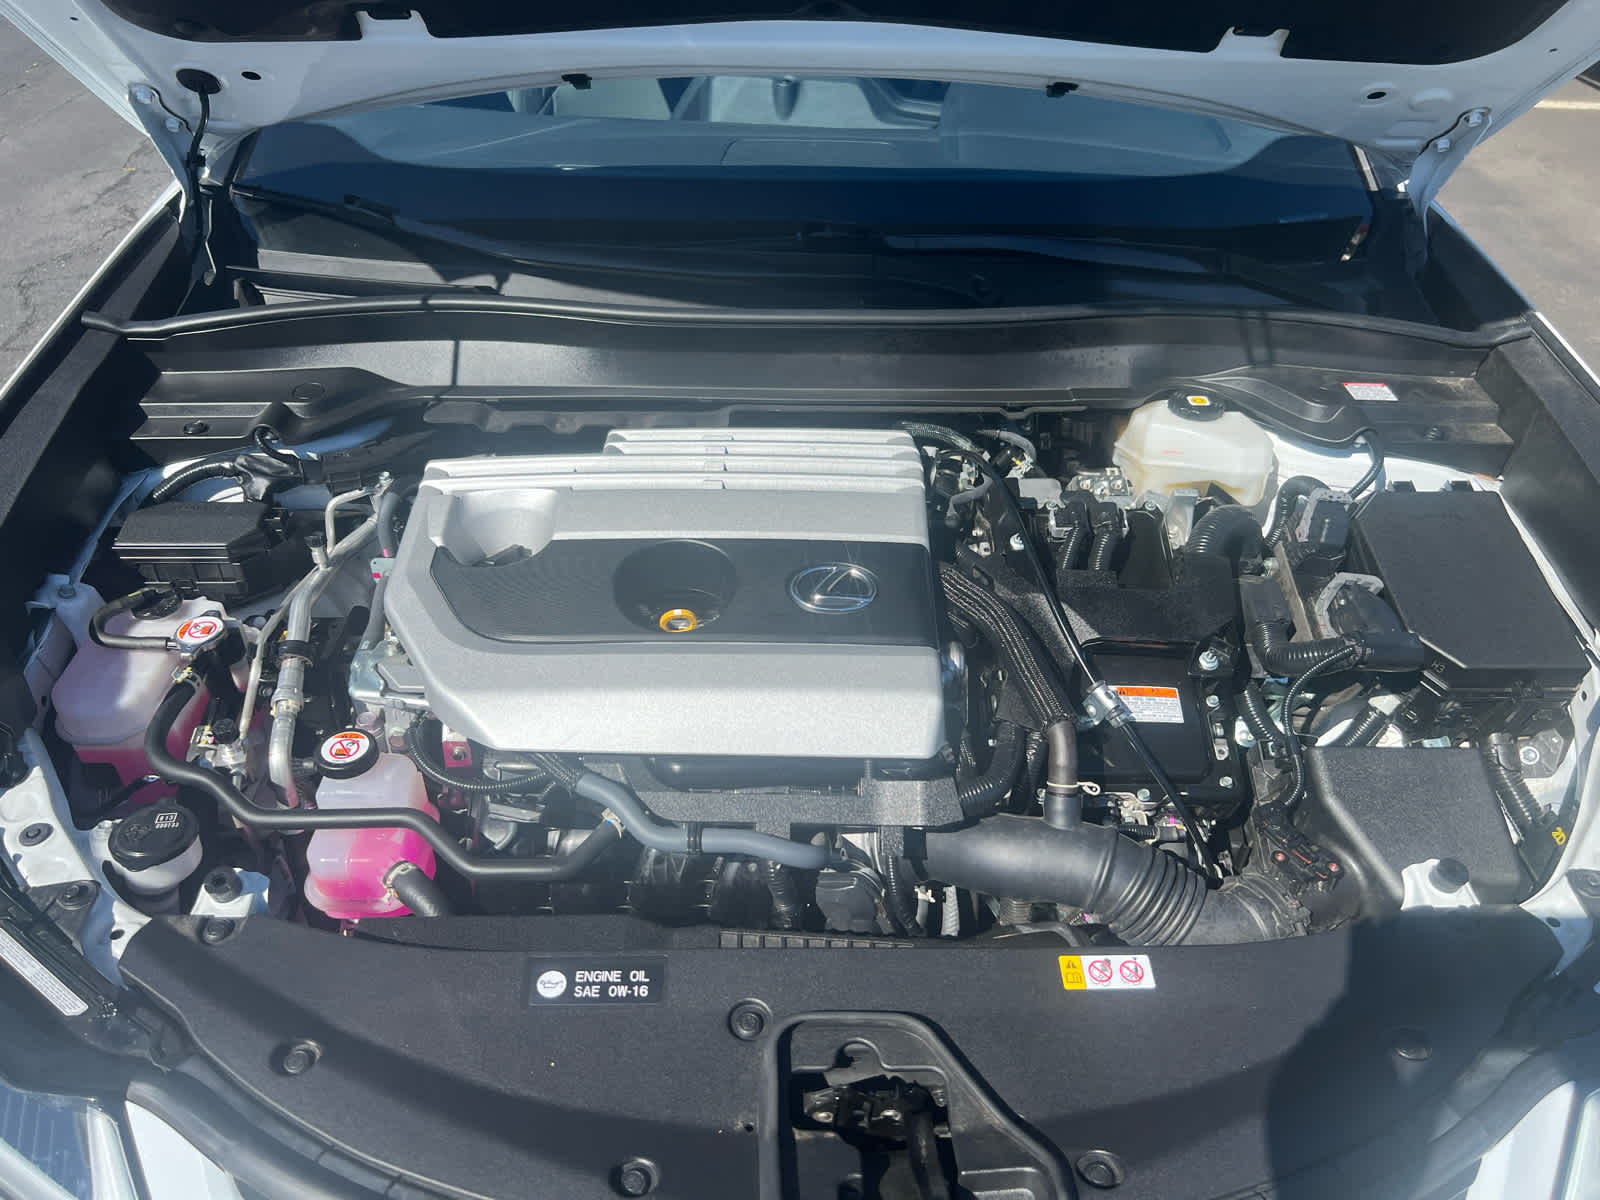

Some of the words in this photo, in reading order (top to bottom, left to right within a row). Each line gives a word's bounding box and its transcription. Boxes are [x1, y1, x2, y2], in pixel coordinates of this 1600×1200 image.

[575, 970, 622, 982] ENGINE
[629, 970, 650, 982] OIL
[573, 985, 601, 998] SAE
